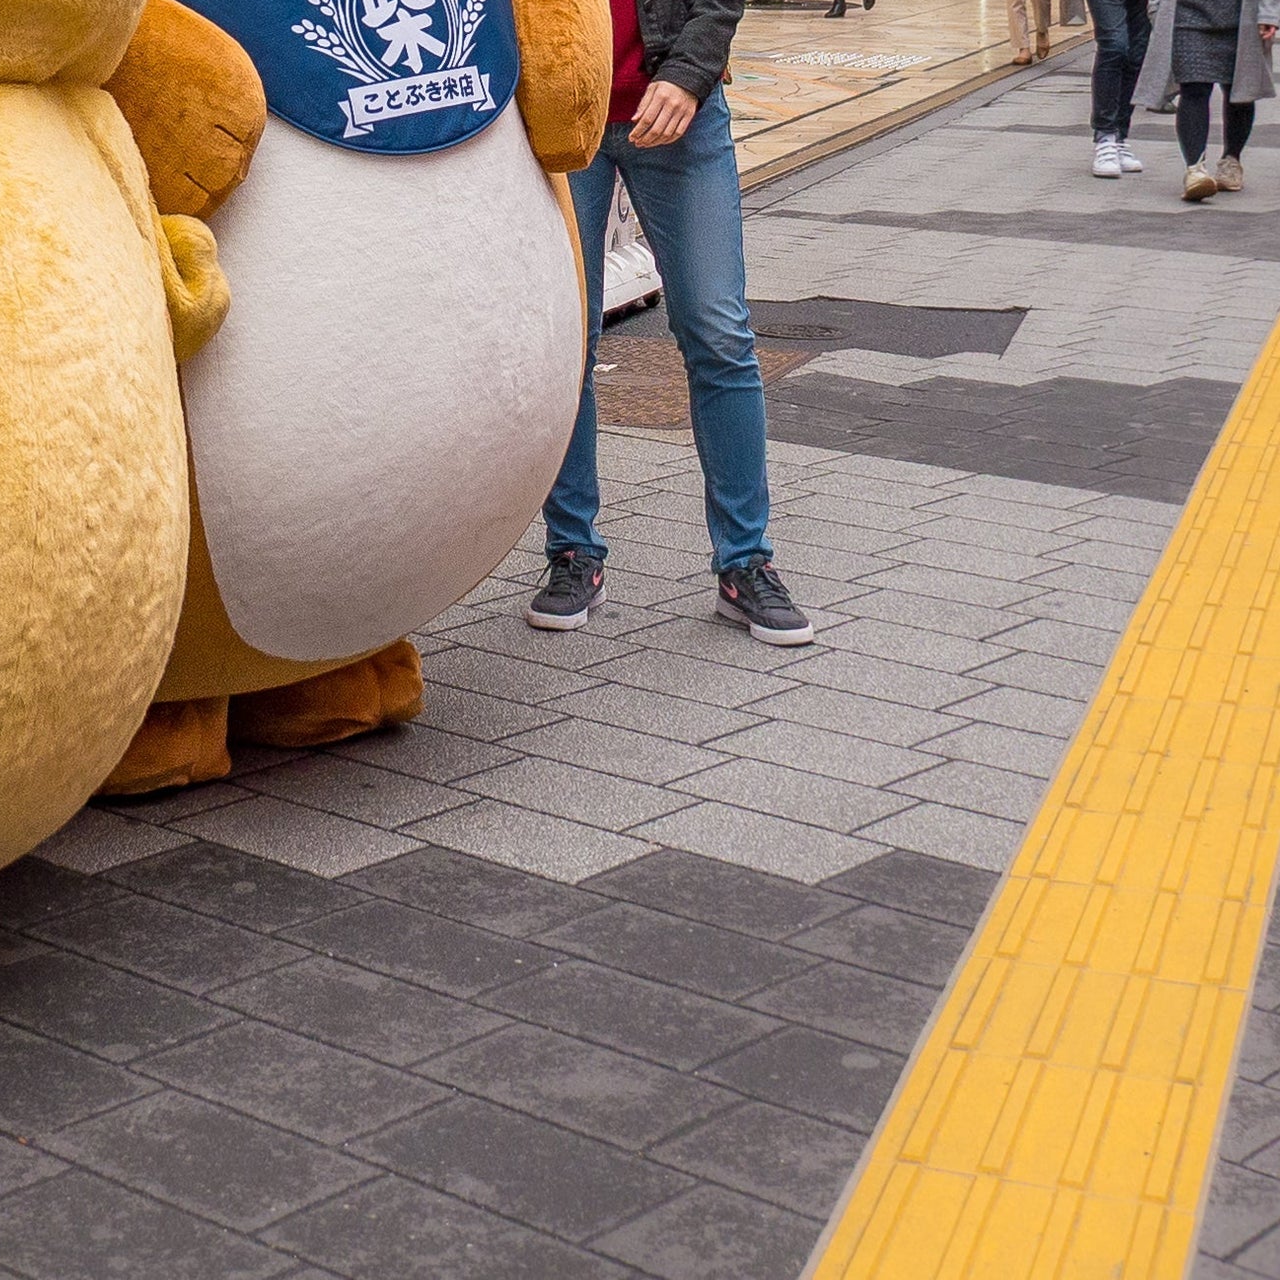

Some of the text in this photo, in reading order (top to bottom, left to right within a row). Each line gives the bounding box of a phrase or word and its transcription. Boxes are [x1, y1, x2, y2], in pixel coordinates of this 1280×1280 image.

[363, 73, 475, 115] ことぶき米店
